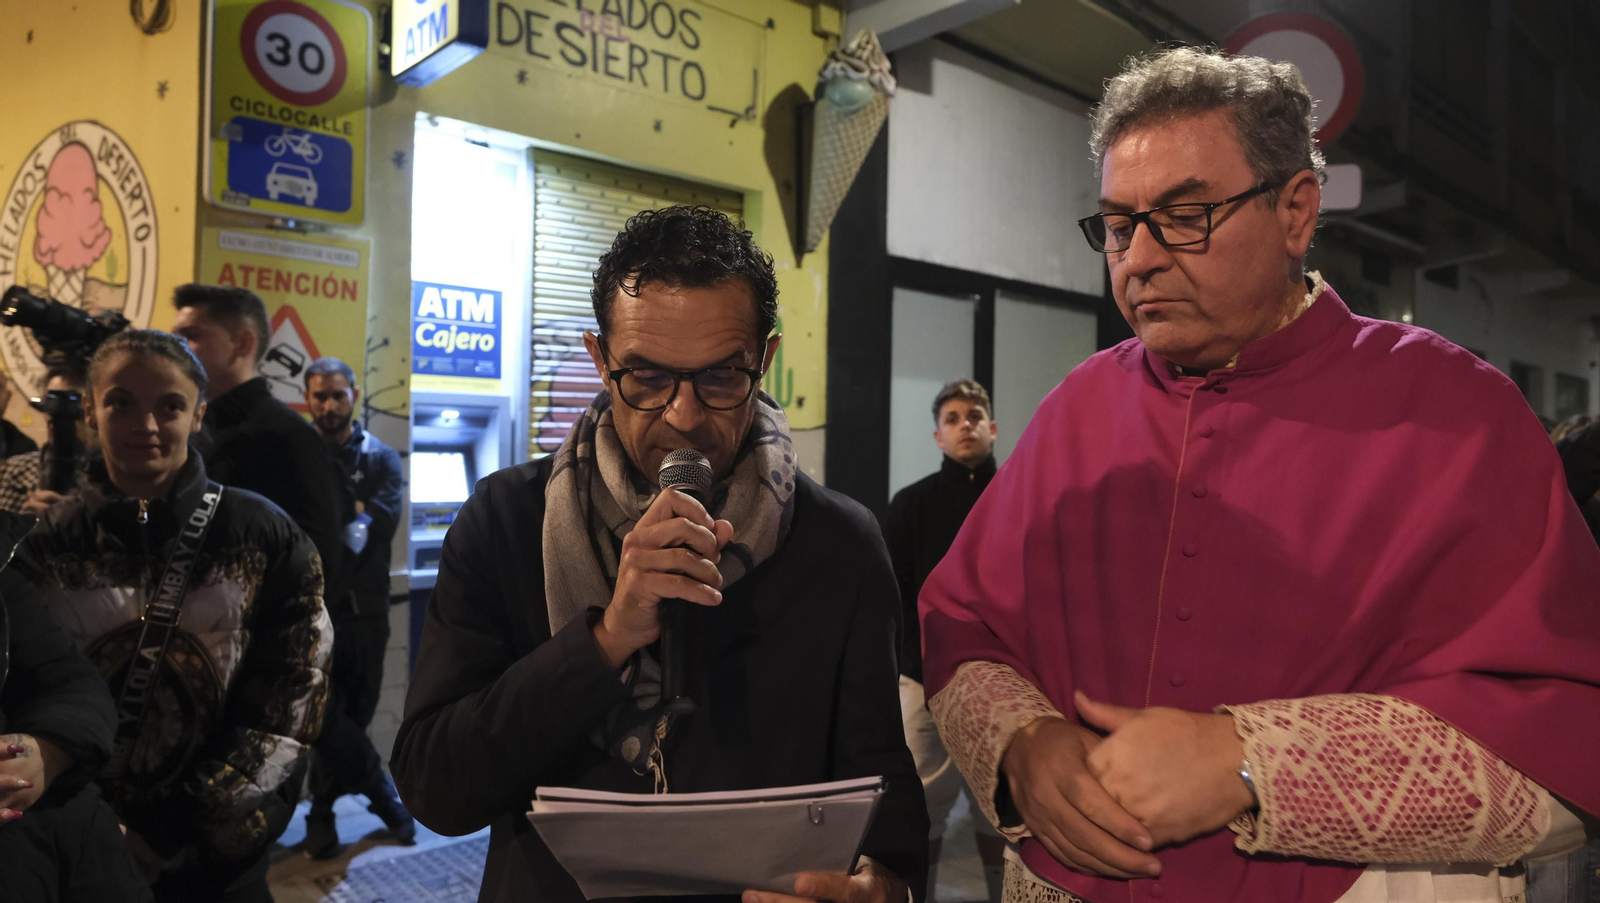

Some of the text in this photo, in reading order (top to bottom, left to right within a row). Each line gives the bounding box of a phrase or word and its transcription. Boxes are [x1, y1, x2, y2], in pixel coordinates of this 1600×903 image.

[405, 3, 448, 62] ATM
[580, 8, 632, 43] DEL
[265, 32, 325, 76] 30
[496, 2, 706, 101] DESIERTO
[230, 96, 353, 135] CICLOCALLE
[0, 152, 47, 276] HELADOS
[97, 135, 152, 243] DESIERTO
[218, 263, 358, 302] ATENCIÓN
[417, 286, 494, 323] ATM
[415, 322, 495, 354] Cajero
[184, 492, 219, 538] LOLA
